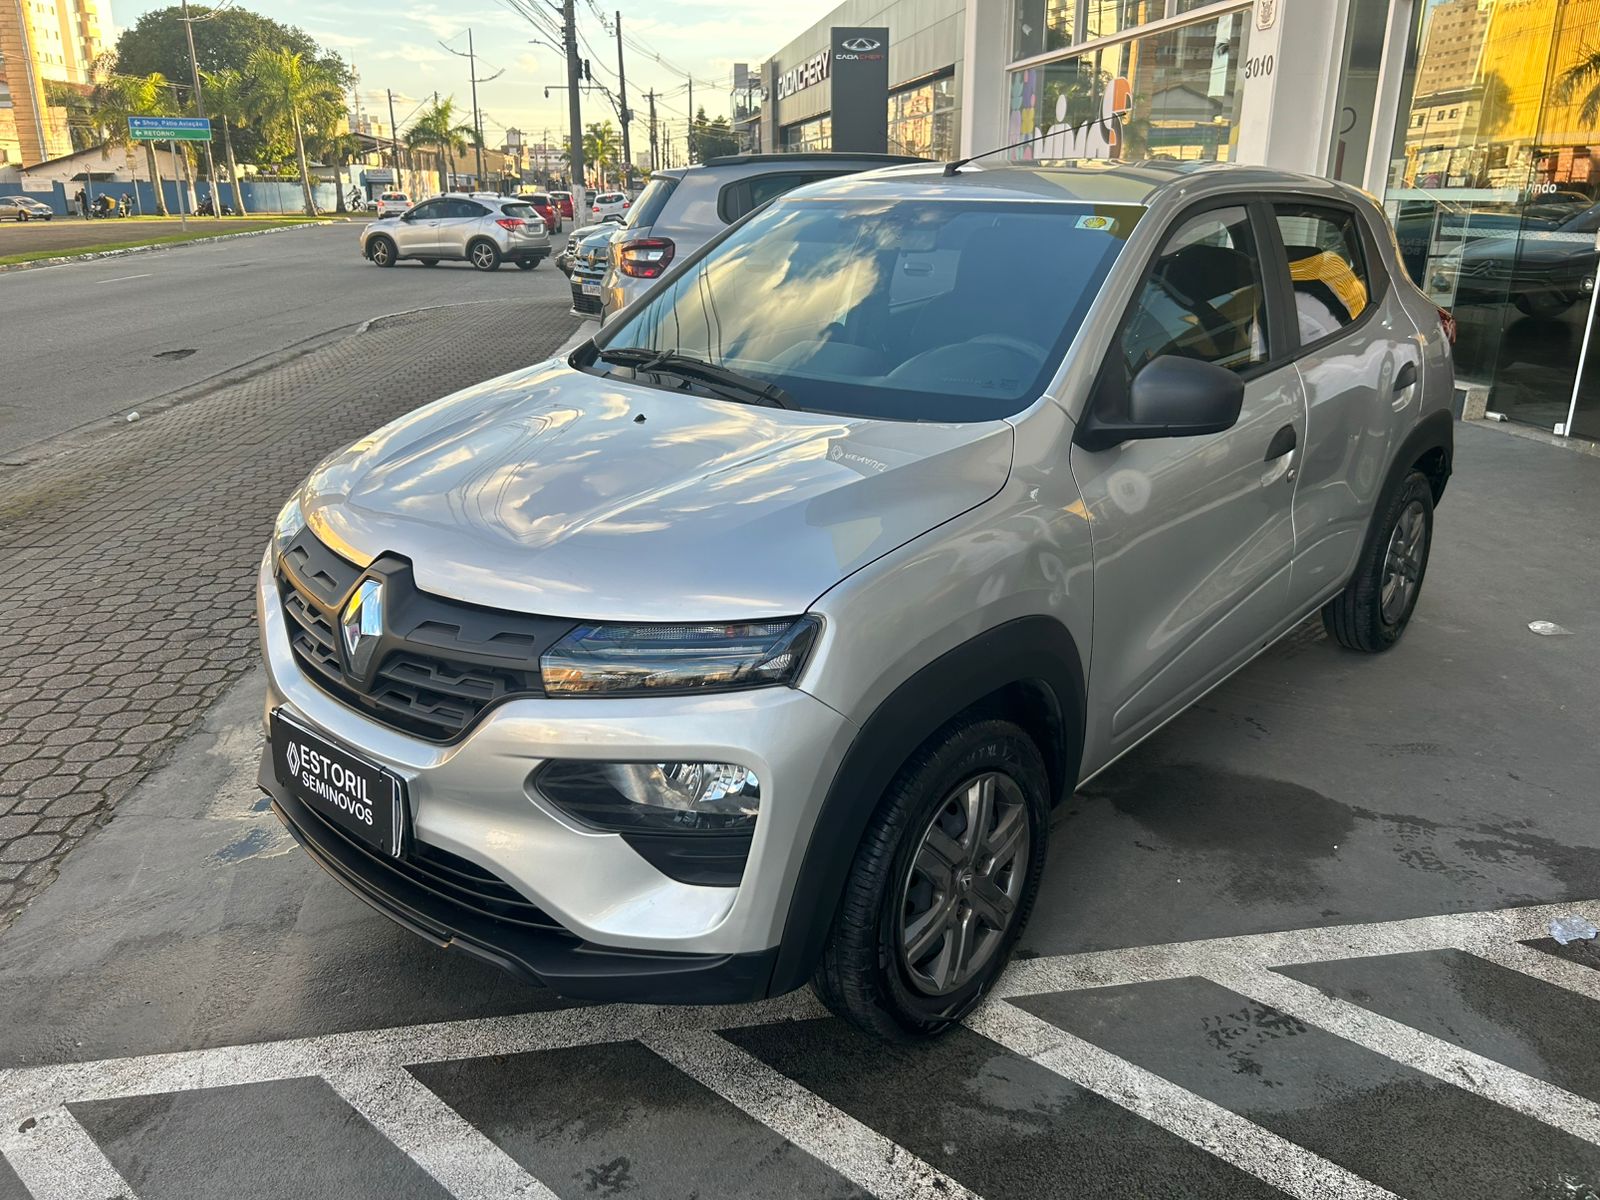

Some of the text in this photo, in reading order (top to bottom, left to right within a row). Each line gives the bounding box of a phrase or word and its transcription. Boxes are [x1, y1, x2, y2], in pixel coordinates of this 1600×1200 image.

[1245, 54, 1274, 80] 3010
[299, 744, 373, 806] ESTORIL
[301, 770, 374, 826] SEMINOVOS
